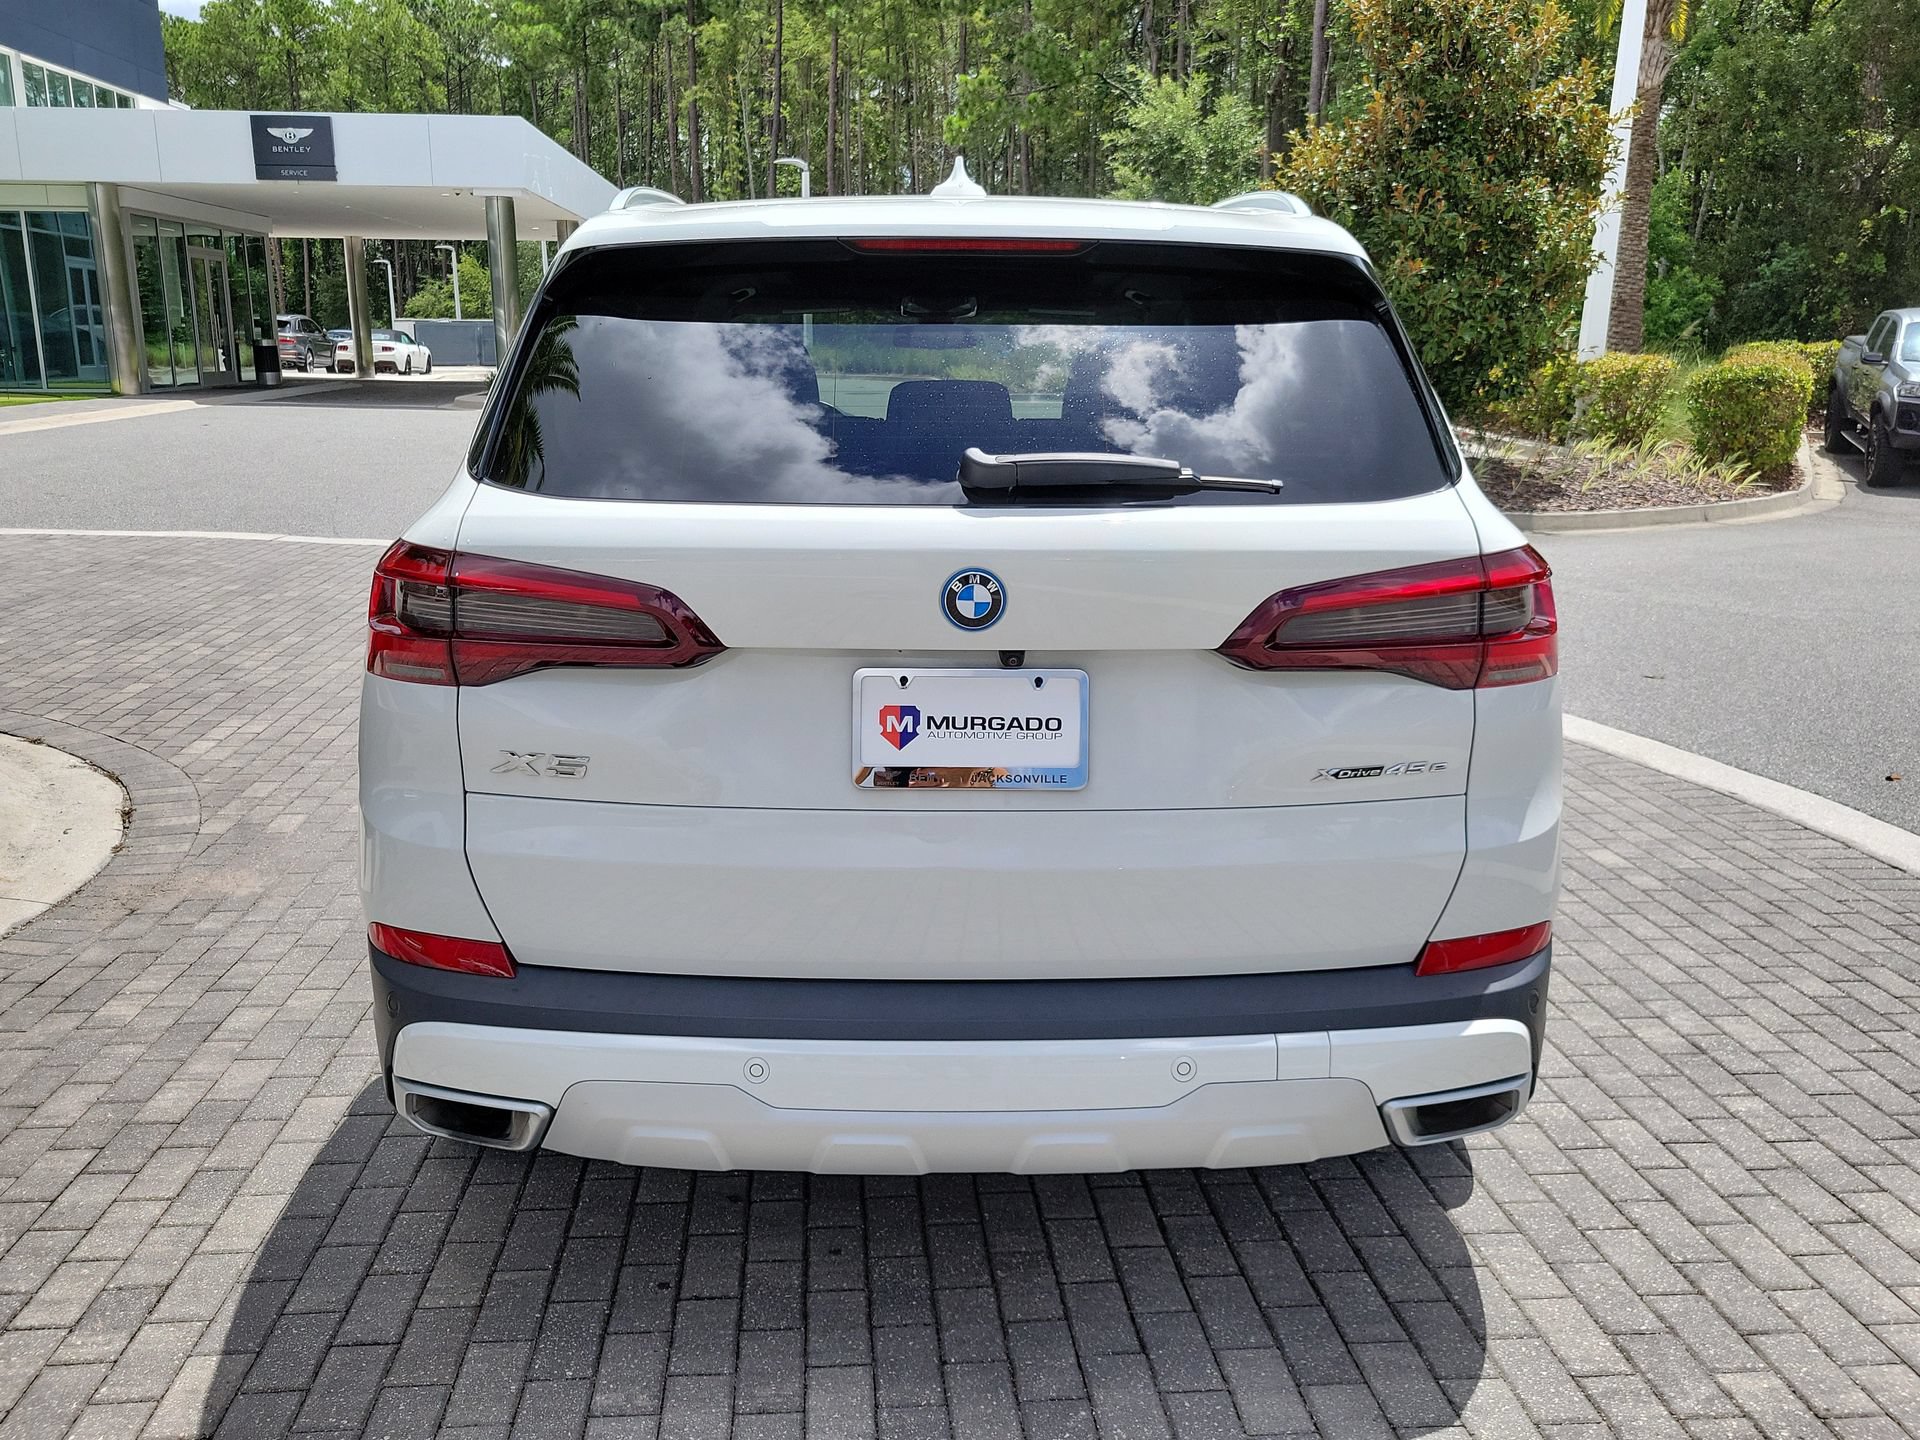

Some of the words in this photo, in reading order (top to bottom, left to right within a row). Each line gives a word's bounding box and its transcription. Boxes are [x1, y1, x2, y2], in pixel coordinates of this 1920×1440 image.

[951, 574, 998, 593] BMW
[886, 715, 914, 733] M
[926, 716, 1062, 731] MURGADO
[927, 731, 1011, 740] AUTOMOTIVE
[1016, 731, 1063, 740] GROUP
[490, 750, 590, 779] X5
[971, 774, 1067, 784] JACKSONVILLE
